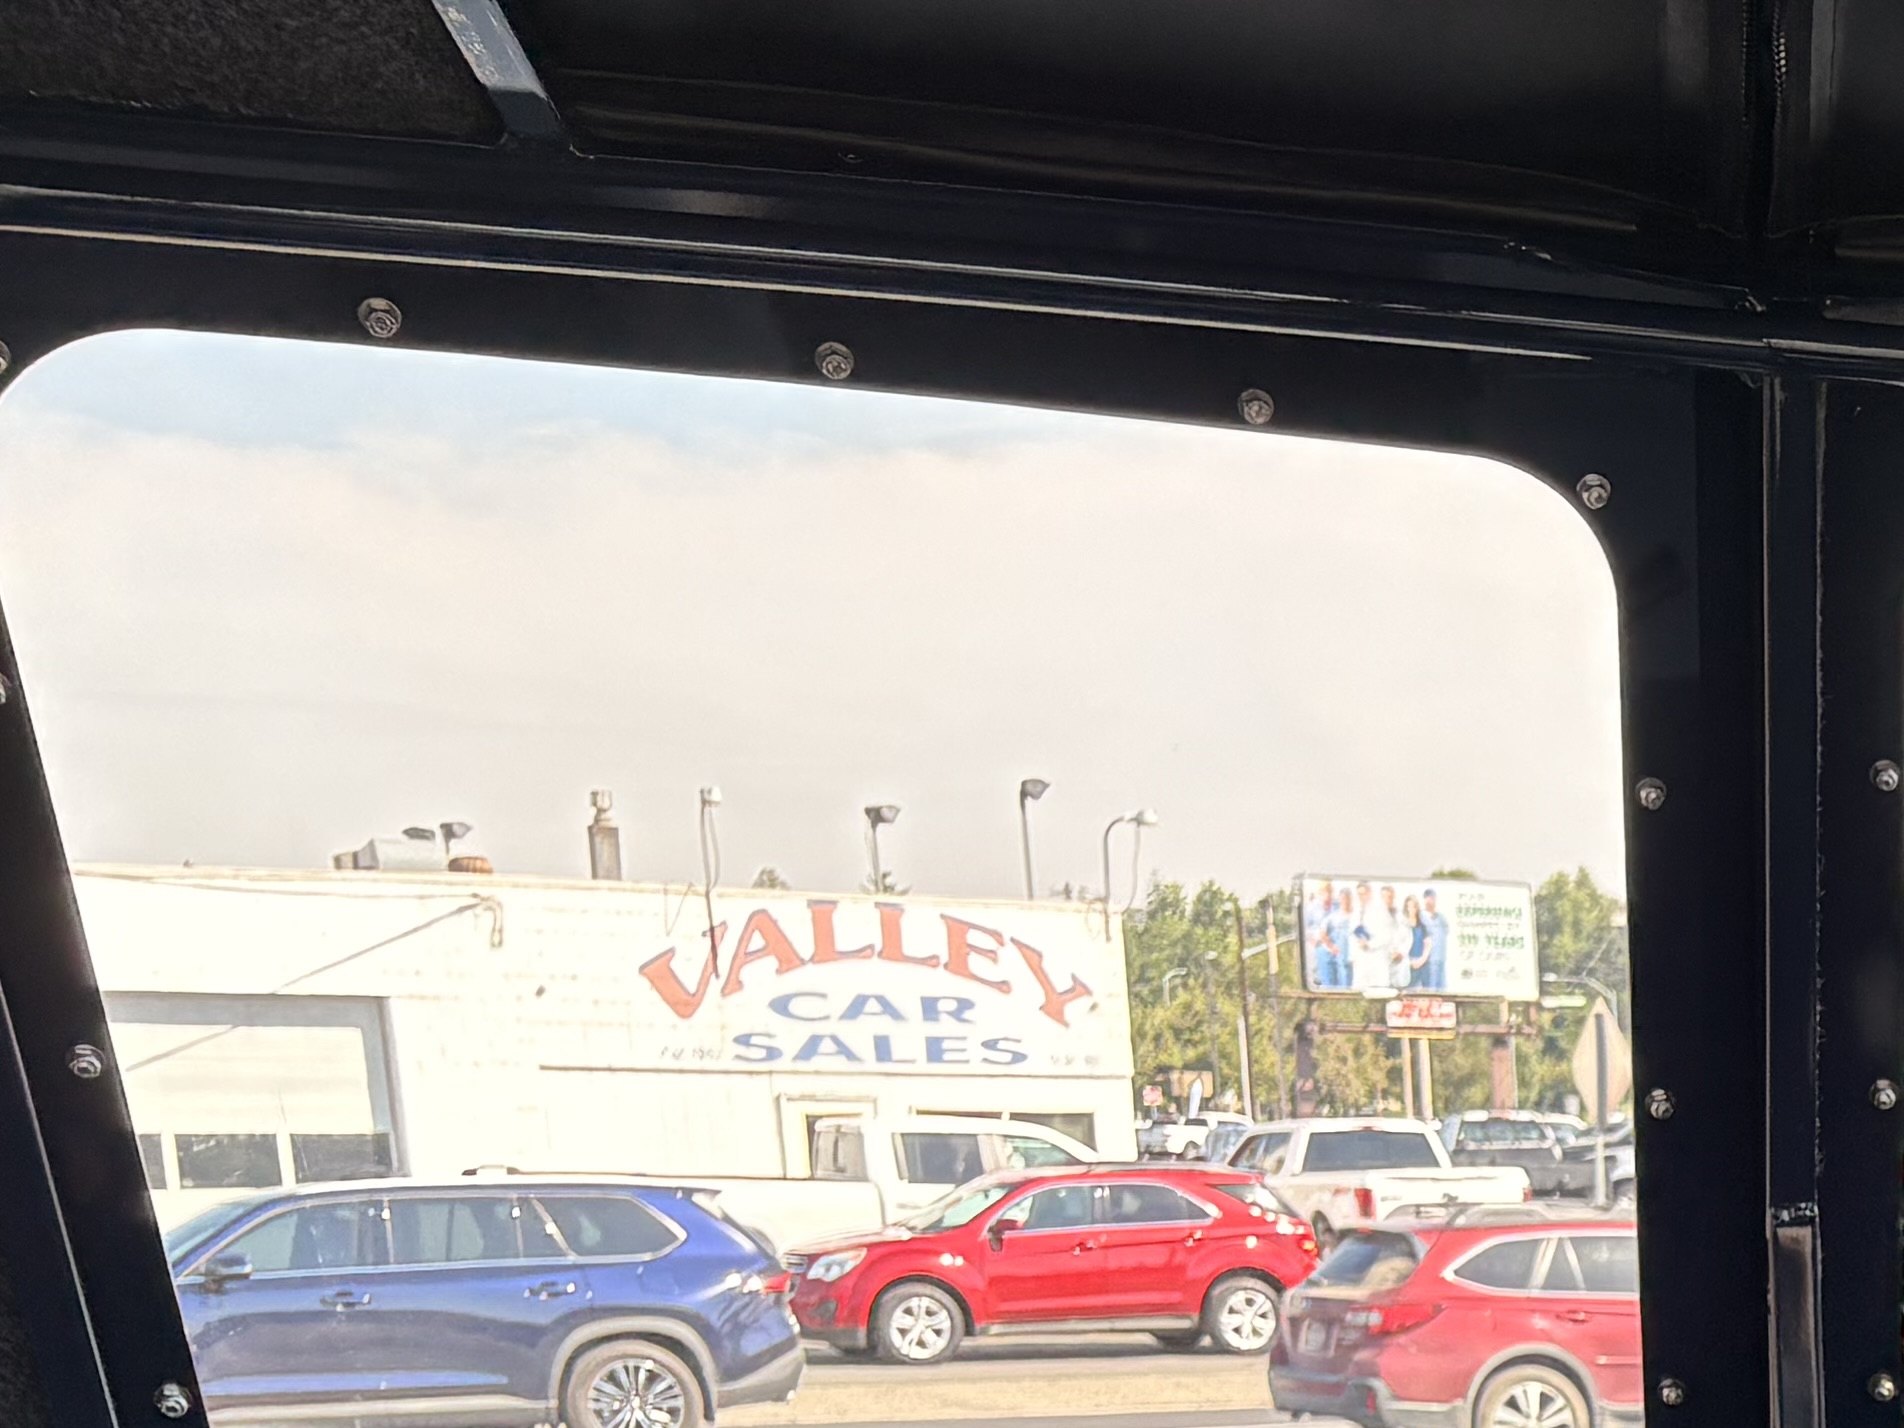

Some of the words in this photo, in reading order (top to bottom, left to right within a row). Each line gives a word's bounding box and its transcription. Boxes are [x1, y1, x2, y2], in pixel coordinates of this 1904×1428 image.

[638, 899, 1093, 1028] VALLEY
[768, 992, 977, 1024] CAR
[732, 1033, 1029, 1065] SALES
